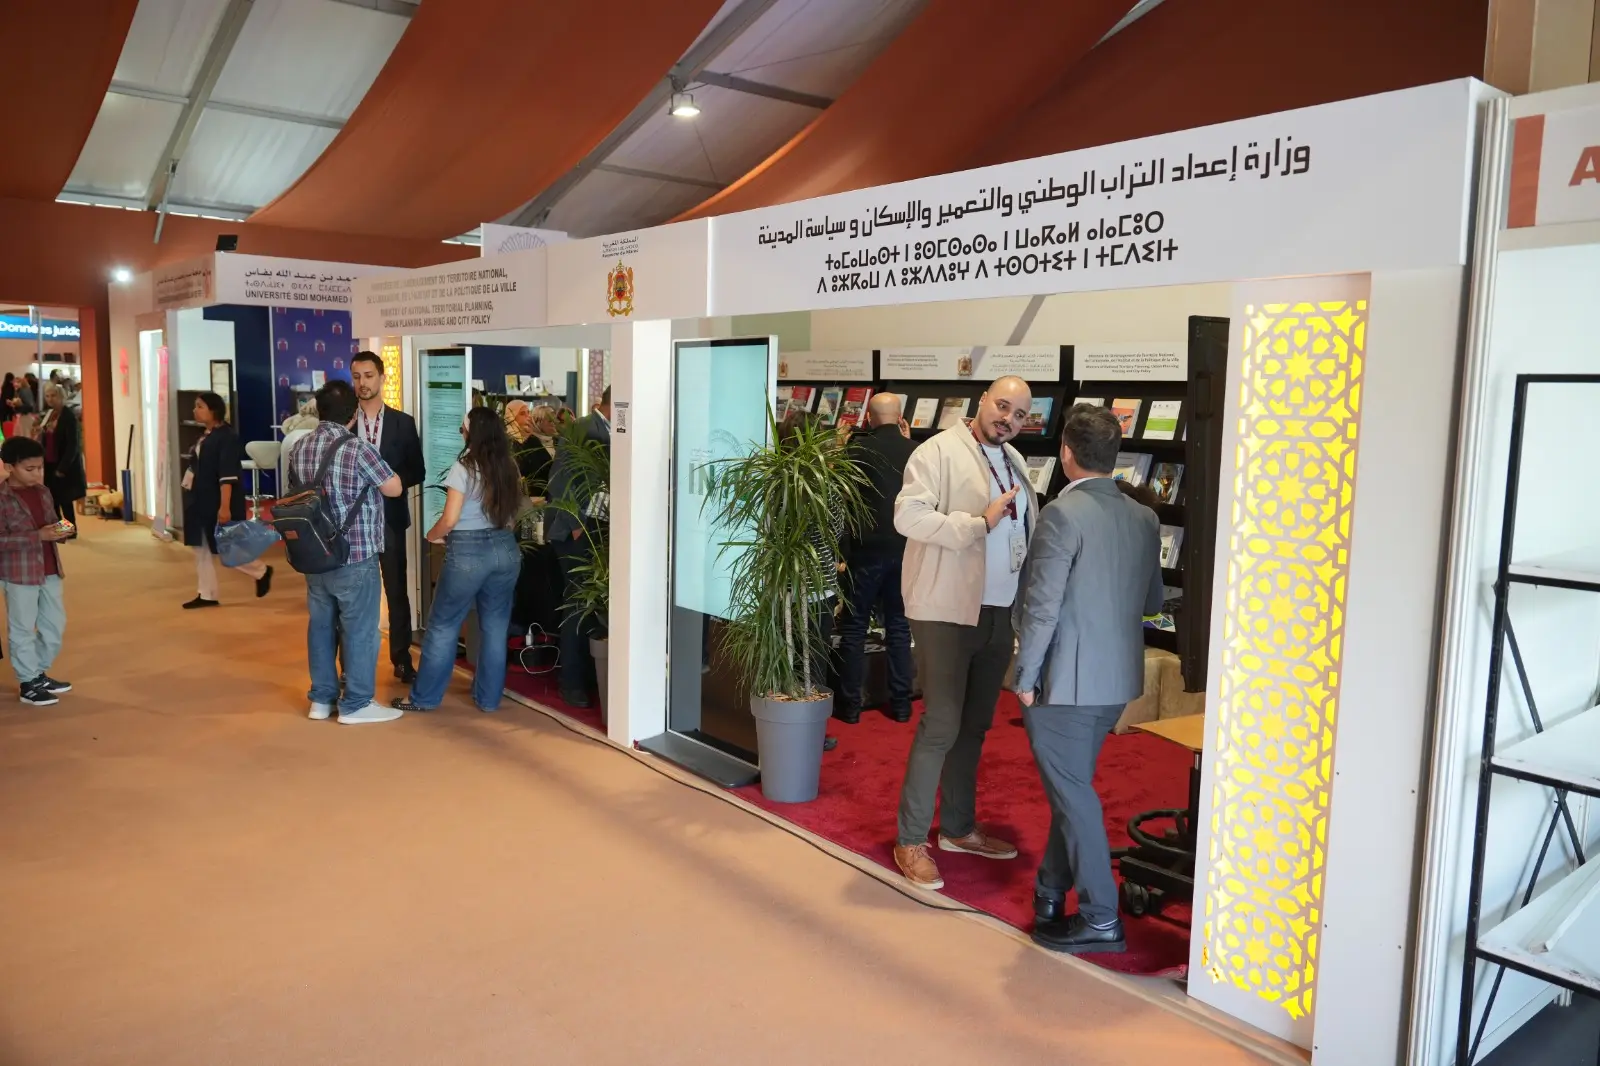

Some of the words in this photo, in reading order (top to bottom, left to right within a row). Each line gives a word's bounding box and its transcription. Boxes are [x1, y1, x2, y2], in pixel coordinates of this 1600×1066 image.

[1172, 145, 1238, 182] إعداد
[1244, 136, 1310, 179] وزارة
[1018, 170, 1095, 214] الوطني
[1100, 158, 1164, 199] التراب
[862, 200, 932, 236] والإسكان
[936, 186, 1012, 226] والتعمير
[758, 220, 802, 249] المدينة
[806, 216, 846, 240] سياسة
[447, 271, 476, 284] TERRITOIRE
[478, 268, 508, 280] NATIONAL,
[454, 284, 482, 296] POLITIQUE
[483, 284, 490, 294] DE
[492, 283, 499, 293] LA
[500, 282, 516, 292] VILLE
[245, 290, 291, 300] UNIVERSITÉ
[294, 293, 308, 301] SIDI
[310, 294, 348, 303] MOHAMED
[465, 300, 493, 312] PLANNING,
[458, 316, 470, 325] CITY
[471, 315, 491, 324] POLICY
